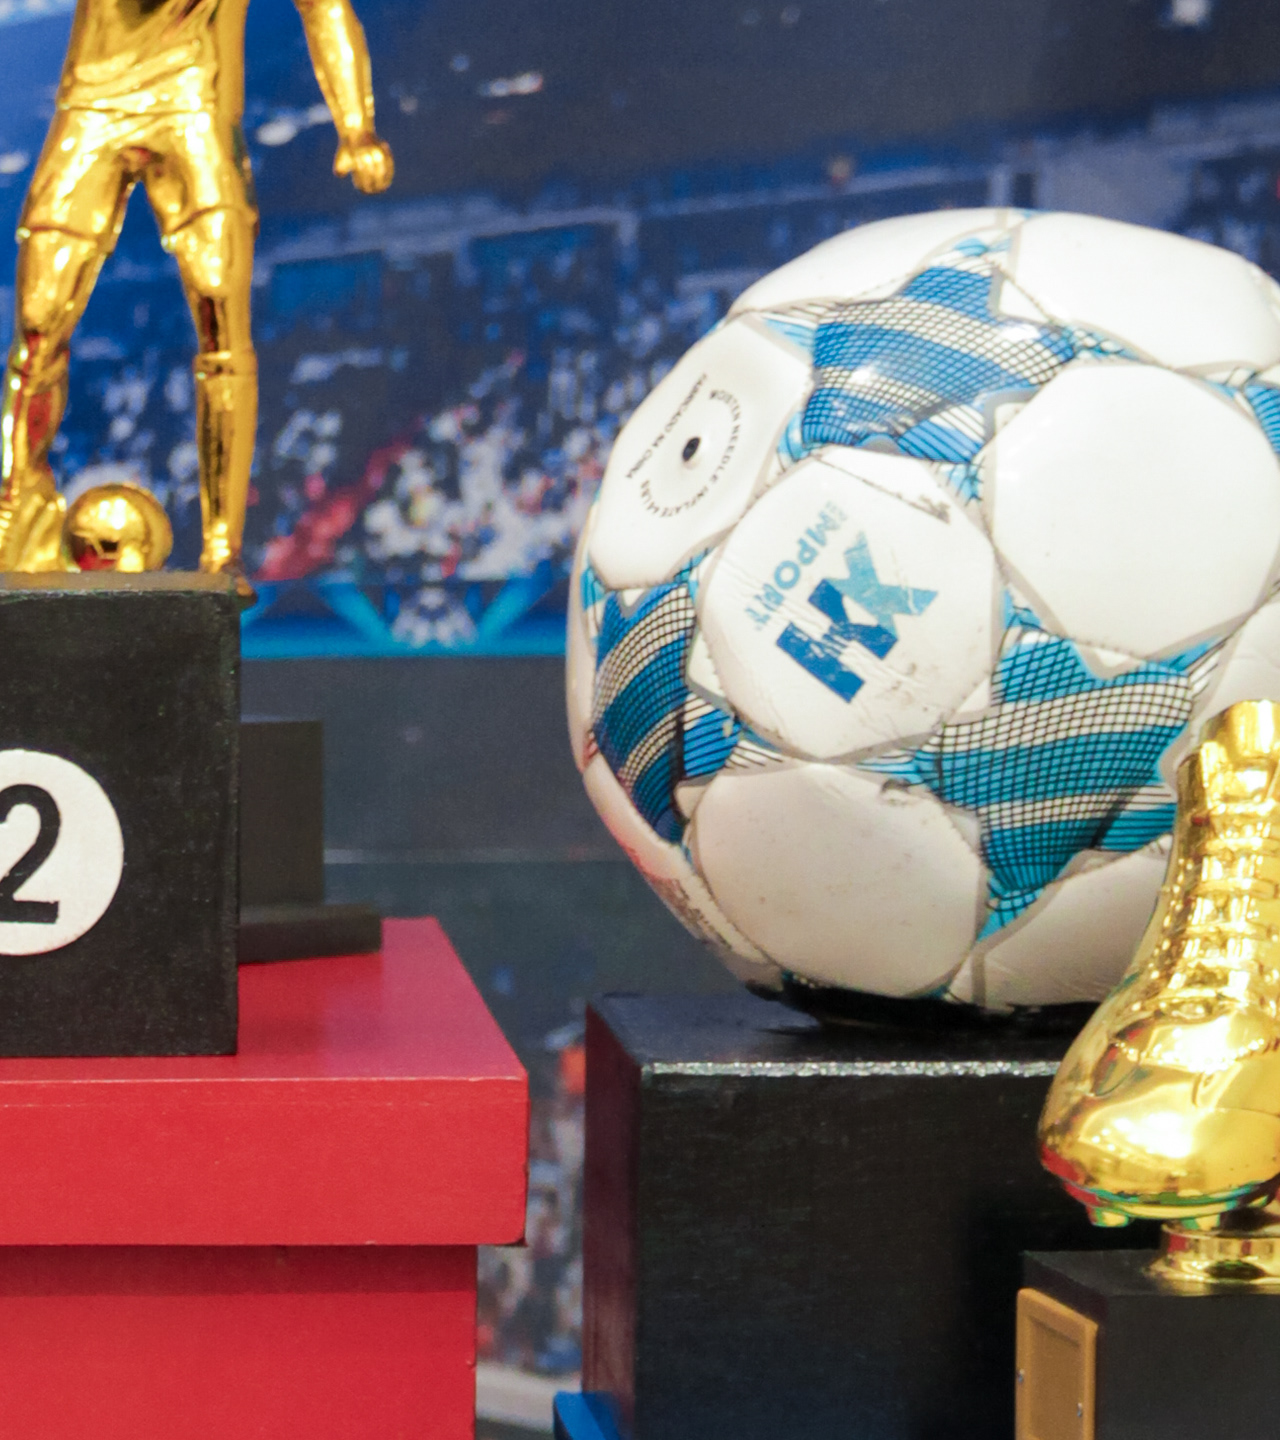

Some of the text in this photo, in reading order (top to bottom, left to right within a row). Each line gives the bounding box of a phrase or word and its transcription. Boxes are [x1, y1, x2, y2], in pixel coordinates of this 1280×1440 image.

[663, 372, 708, 433] FABRICADO
[651, 434, 666, 448] NA
[709, 423, 741, 483] NEEDLE
